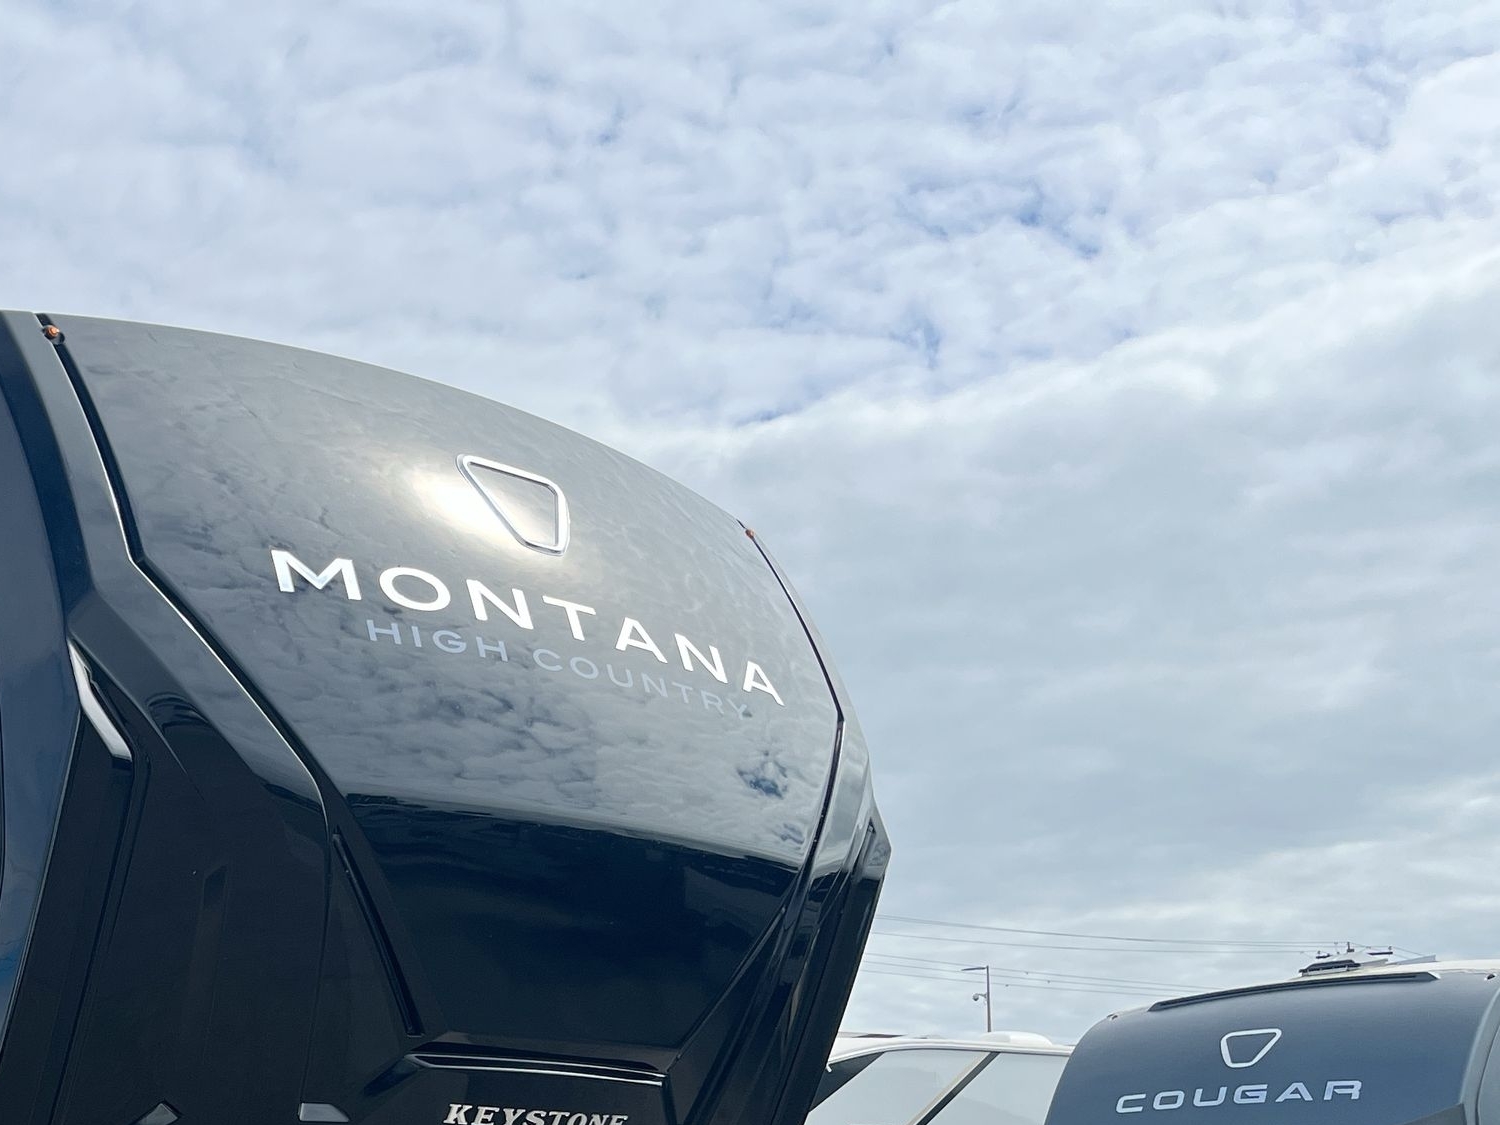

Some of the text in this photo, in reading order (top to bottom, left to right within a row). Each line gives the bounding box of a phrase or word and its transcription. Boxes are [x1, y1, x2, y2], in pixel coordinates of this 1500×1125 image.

[270, 548, 785, 706] MONTANA
[366, 619, 749, 721] HIGH COUNTRY
[1116, 1080, 1362, 1114] COUGAR
